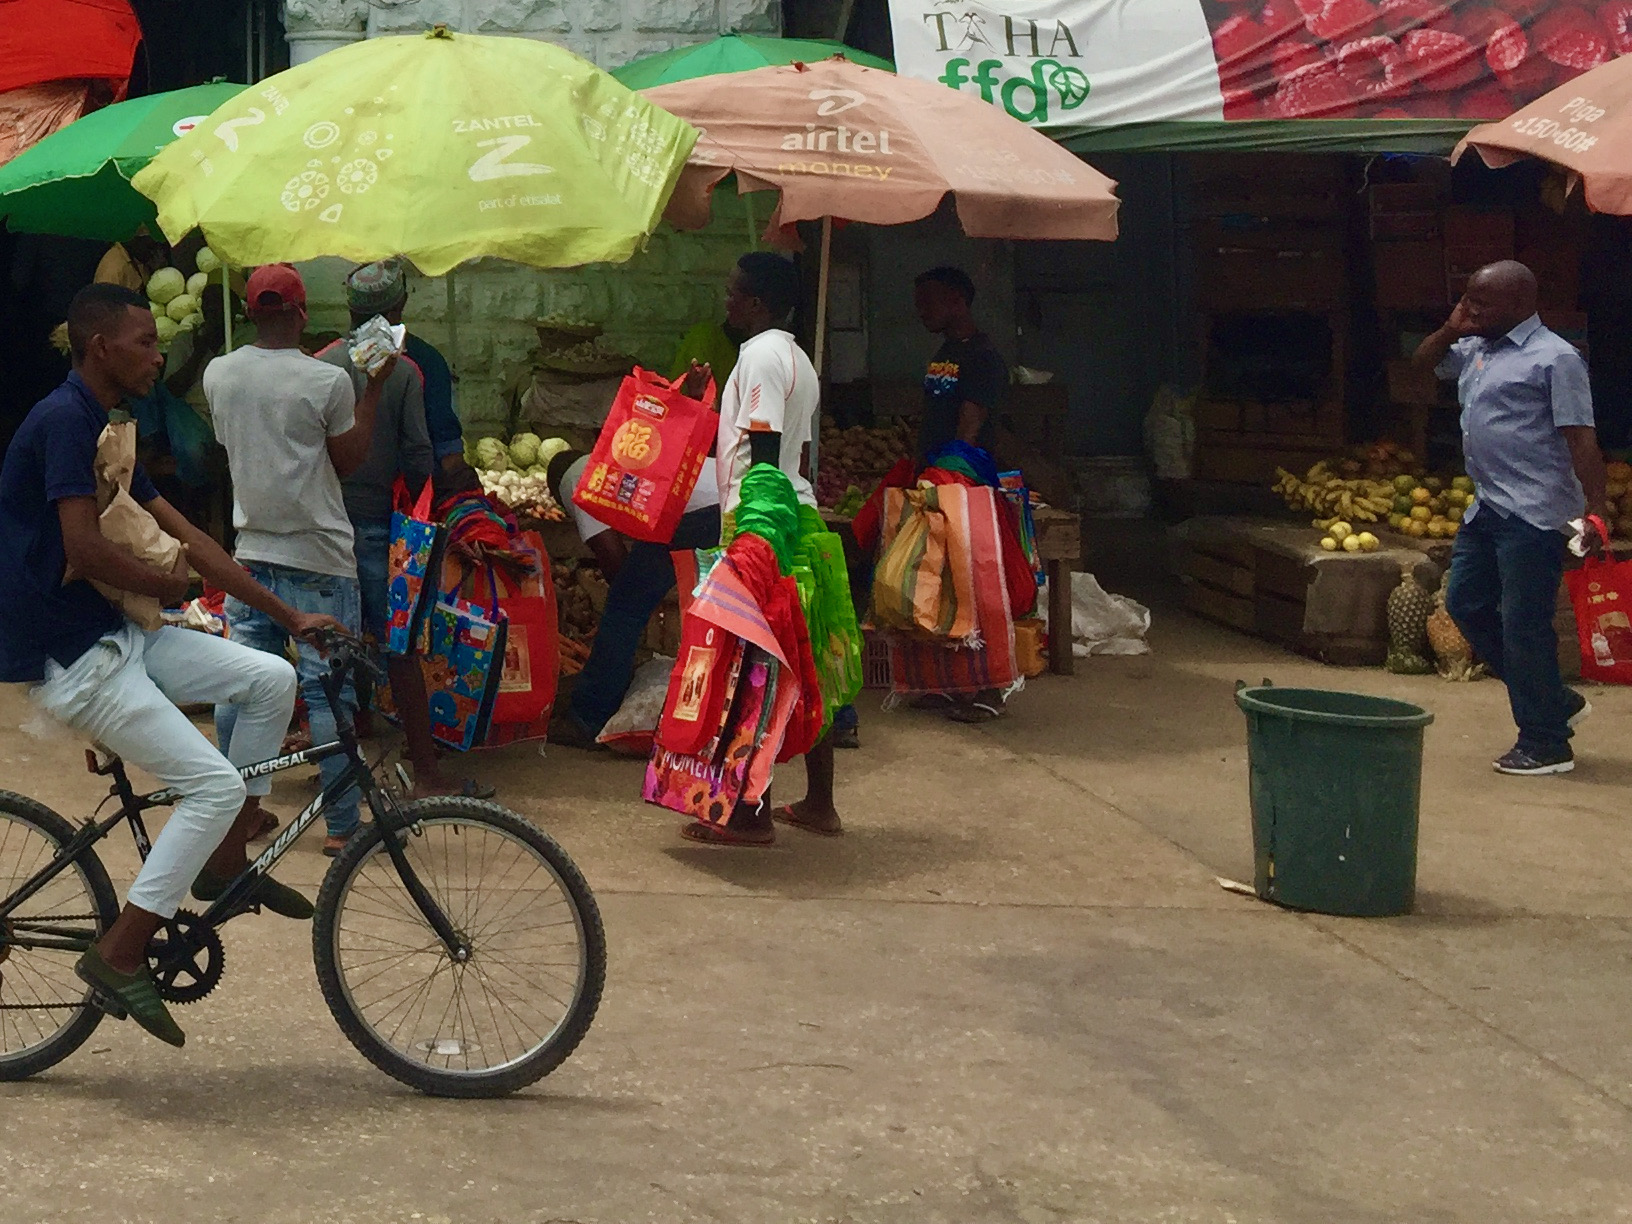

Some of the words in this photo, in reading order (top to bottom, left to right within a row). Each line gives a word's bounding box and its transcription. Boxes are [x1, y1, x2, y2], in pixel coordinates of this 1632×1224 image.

[1558, 96, 1606, 123] Piga
[452, 114, 543, 133] ZANTEL
[780, 123, 894, 155] airtel
[777, 161, 893, 182] money
[478, 198, 504, 212] part
